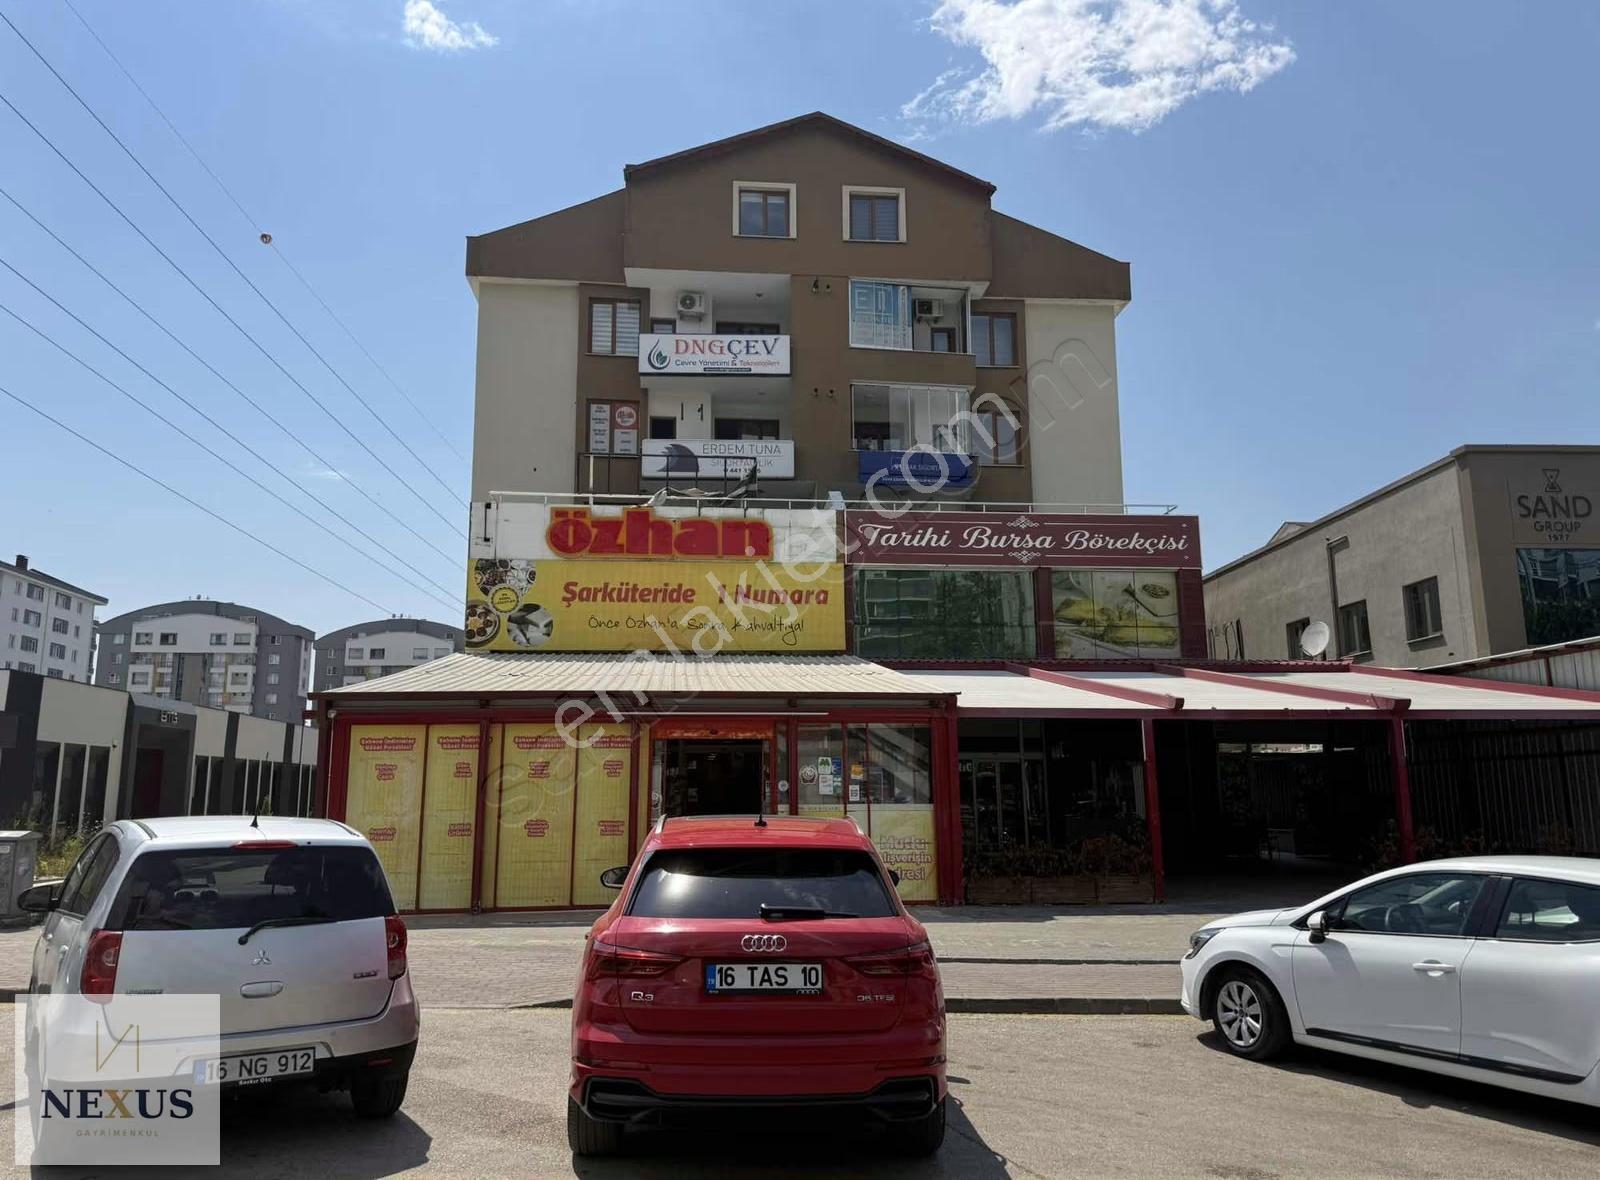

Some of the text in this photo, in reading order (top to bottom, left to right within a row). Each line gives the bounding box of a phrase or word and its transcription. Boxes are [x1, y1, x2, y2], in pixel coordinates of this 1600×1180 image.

[674, 337, 779, 359] DNGÇEV
[703, 443, 782, 454] ERDEM TUNA
[1517, 495, 1592, 518] SAND
[548, 507, 772, 559] özhan
[1534, 521, 1581, 532] GROUP
[858, 523, 1188, 554] Tarihi Bursa Börekçisi
[561, 581, 696, 607] Şarküteride
[735, 583, 829, 605] Numara
[717, 966, 820, 987] 16 TAS 10
[631, 991, 654, 1001] Q3
[207, 1062, 228, 1081] 16
[239, 1058, 268, 1078] NG
[278, 1053, 312, 1073] 912
